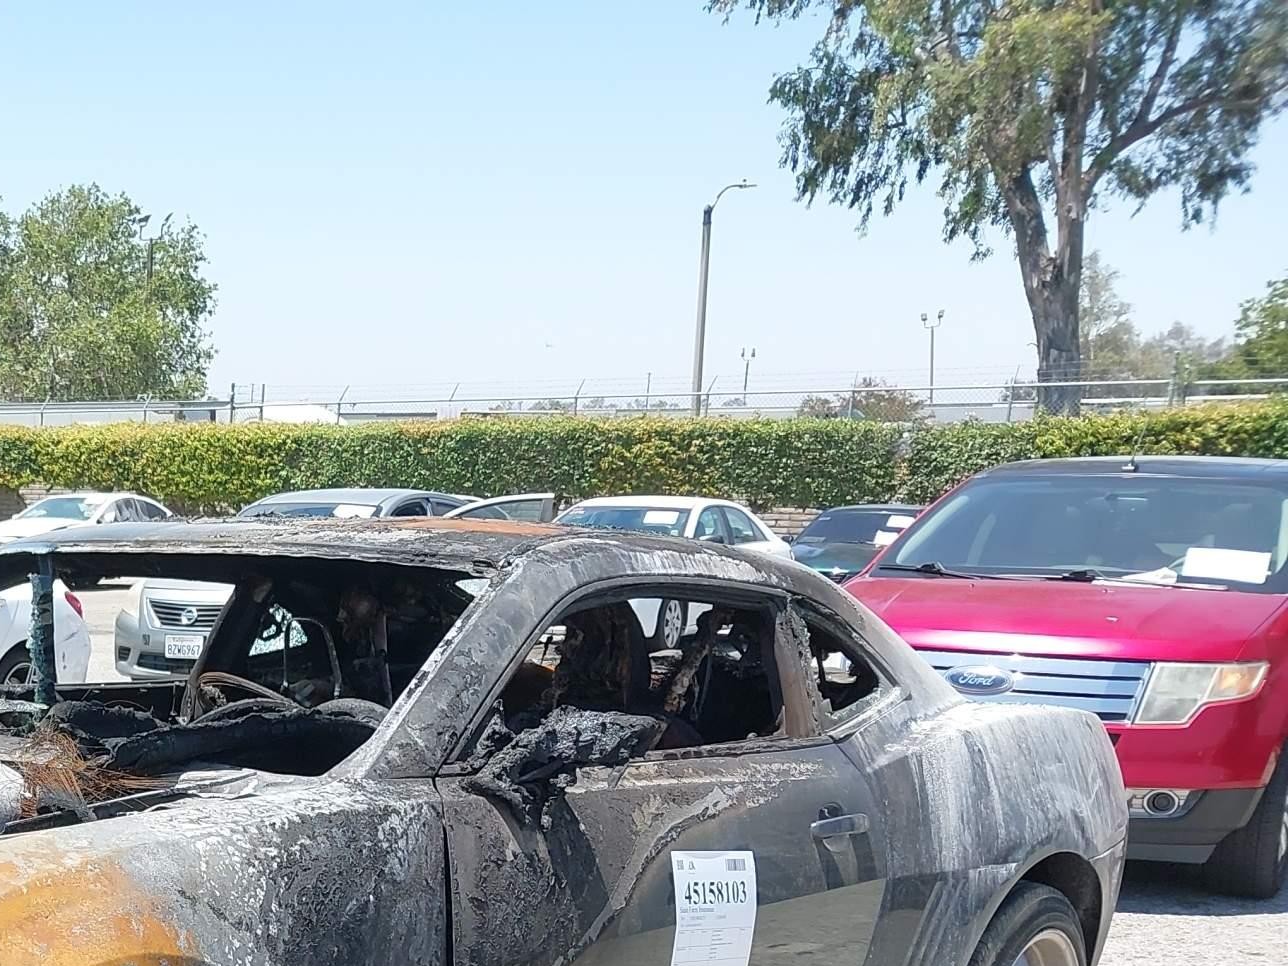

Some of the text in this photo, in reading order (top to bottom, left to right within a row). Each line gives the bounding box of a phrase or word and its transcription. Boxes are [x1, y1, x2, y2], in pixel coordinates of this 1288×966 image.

[167, 644, 200, 655] 8ZWG967
[959, 672, 995, 686] Ford
[684, 881, 747, 904] 45158103
